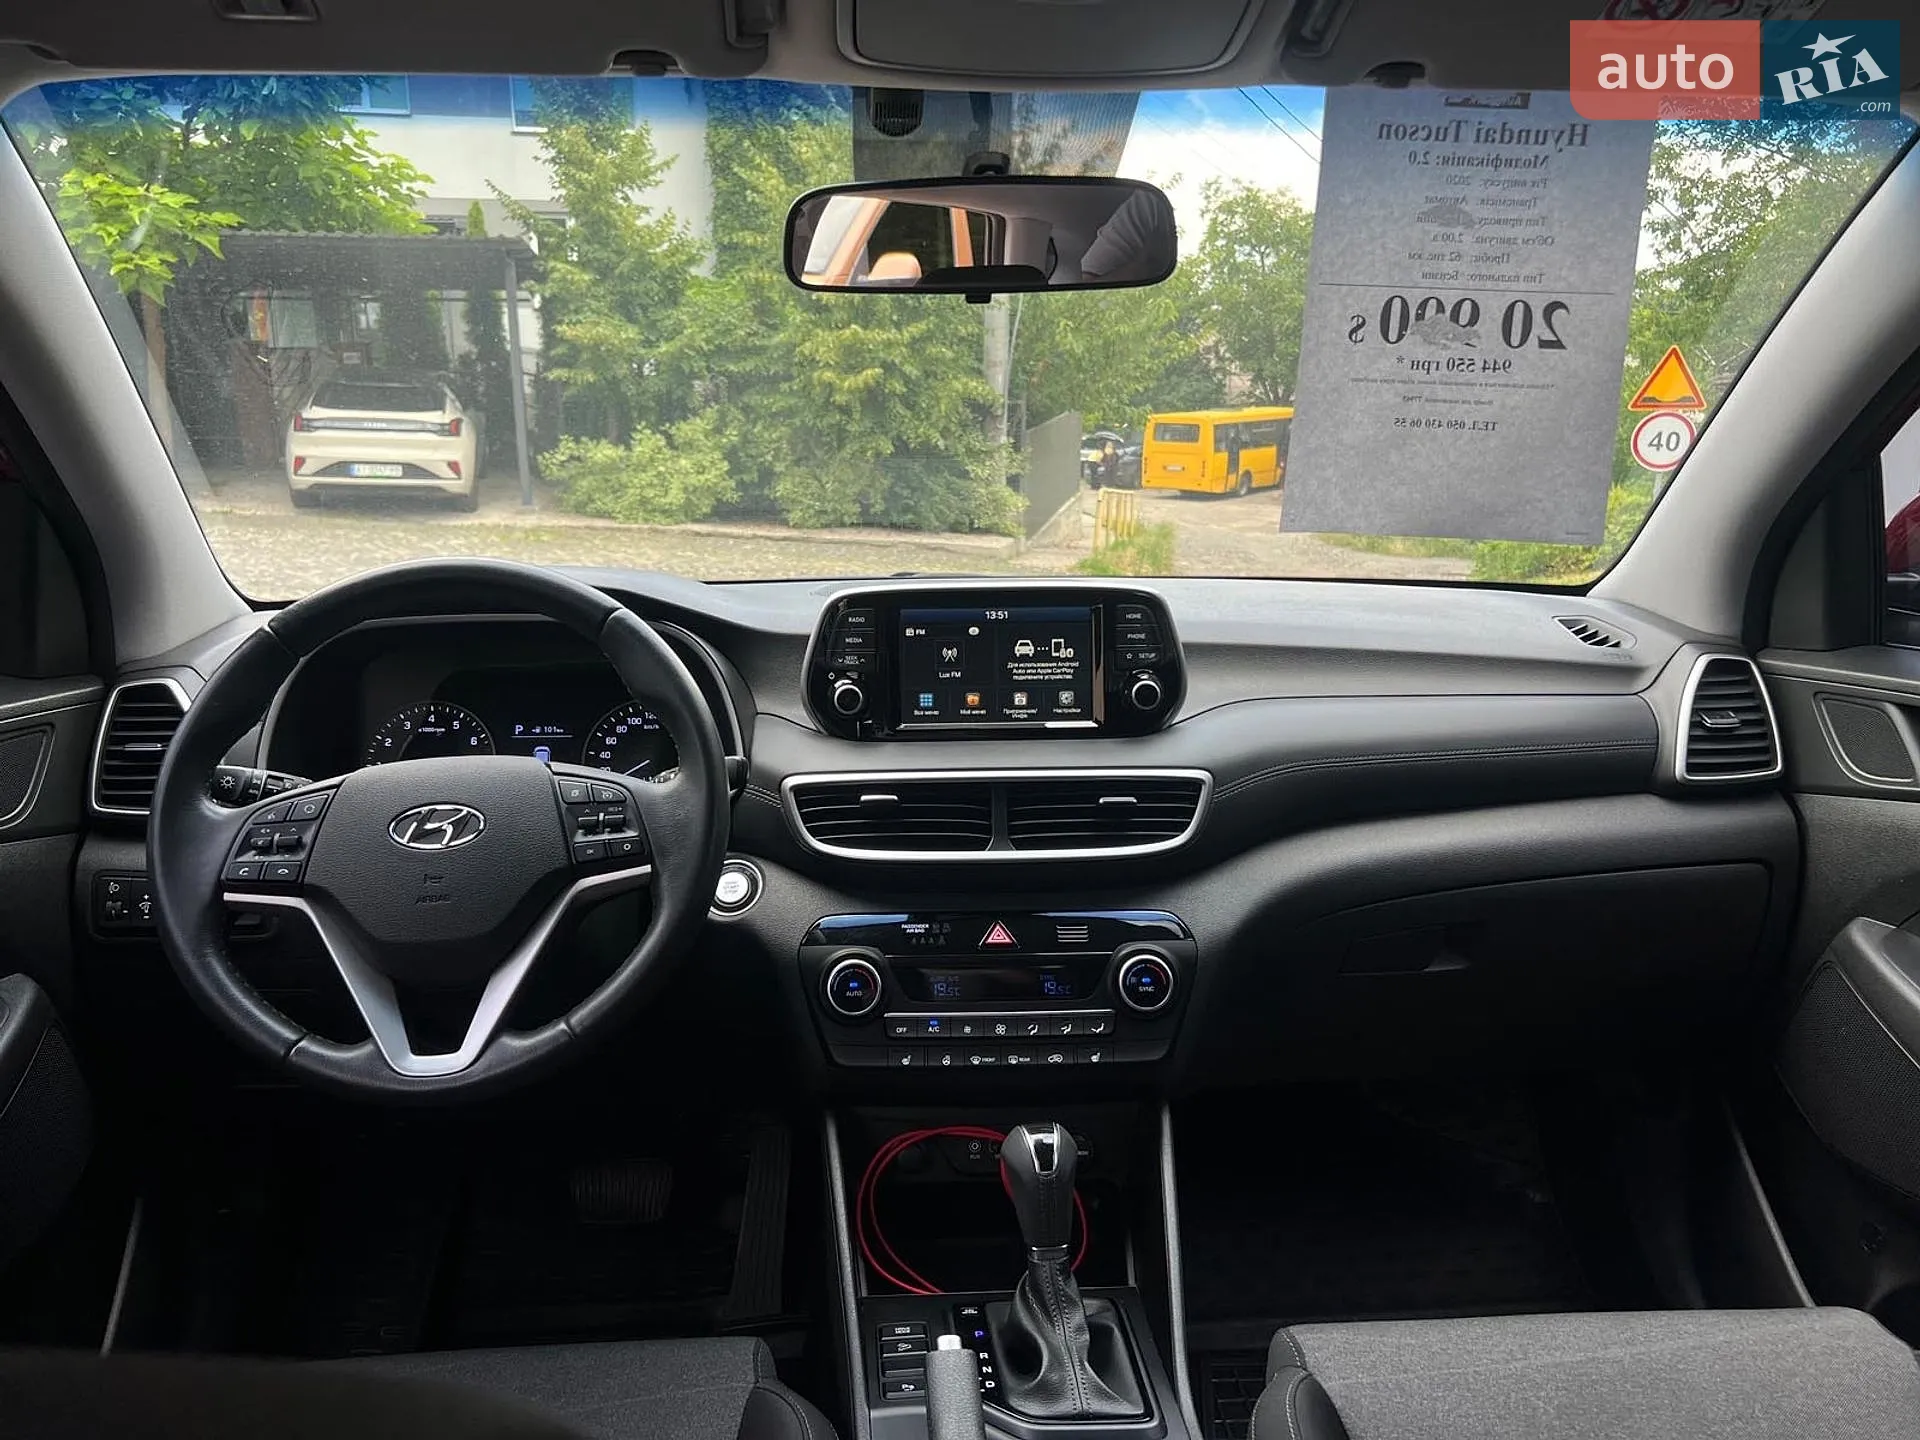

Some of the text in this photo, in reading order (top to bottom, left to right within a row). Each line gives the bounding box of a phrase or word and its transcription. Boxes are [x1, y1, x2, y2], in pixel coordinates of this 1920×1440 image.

[1648, 431, 1680, 452] 40
[984, 610, 1009, 620] 13:51
[428, 714, 435, 722] 4
[627, 717, 642, 725] 100
[403, 721, 411, 730] 3
[452, 721, 460, 730] 5
[515, 724, 524, 735] P
[616, 725, 627, 733] 80
[384, 738, 392, 747] 2
[470, 737, 478, 745] 6
[605, 736, 617, 745] 60
[599, 751, 611, 759] 40
[974, 1330, 984, 1338] P
[979, 1352, 989, 1360] R
[982, 1365, 993, 1373] N
